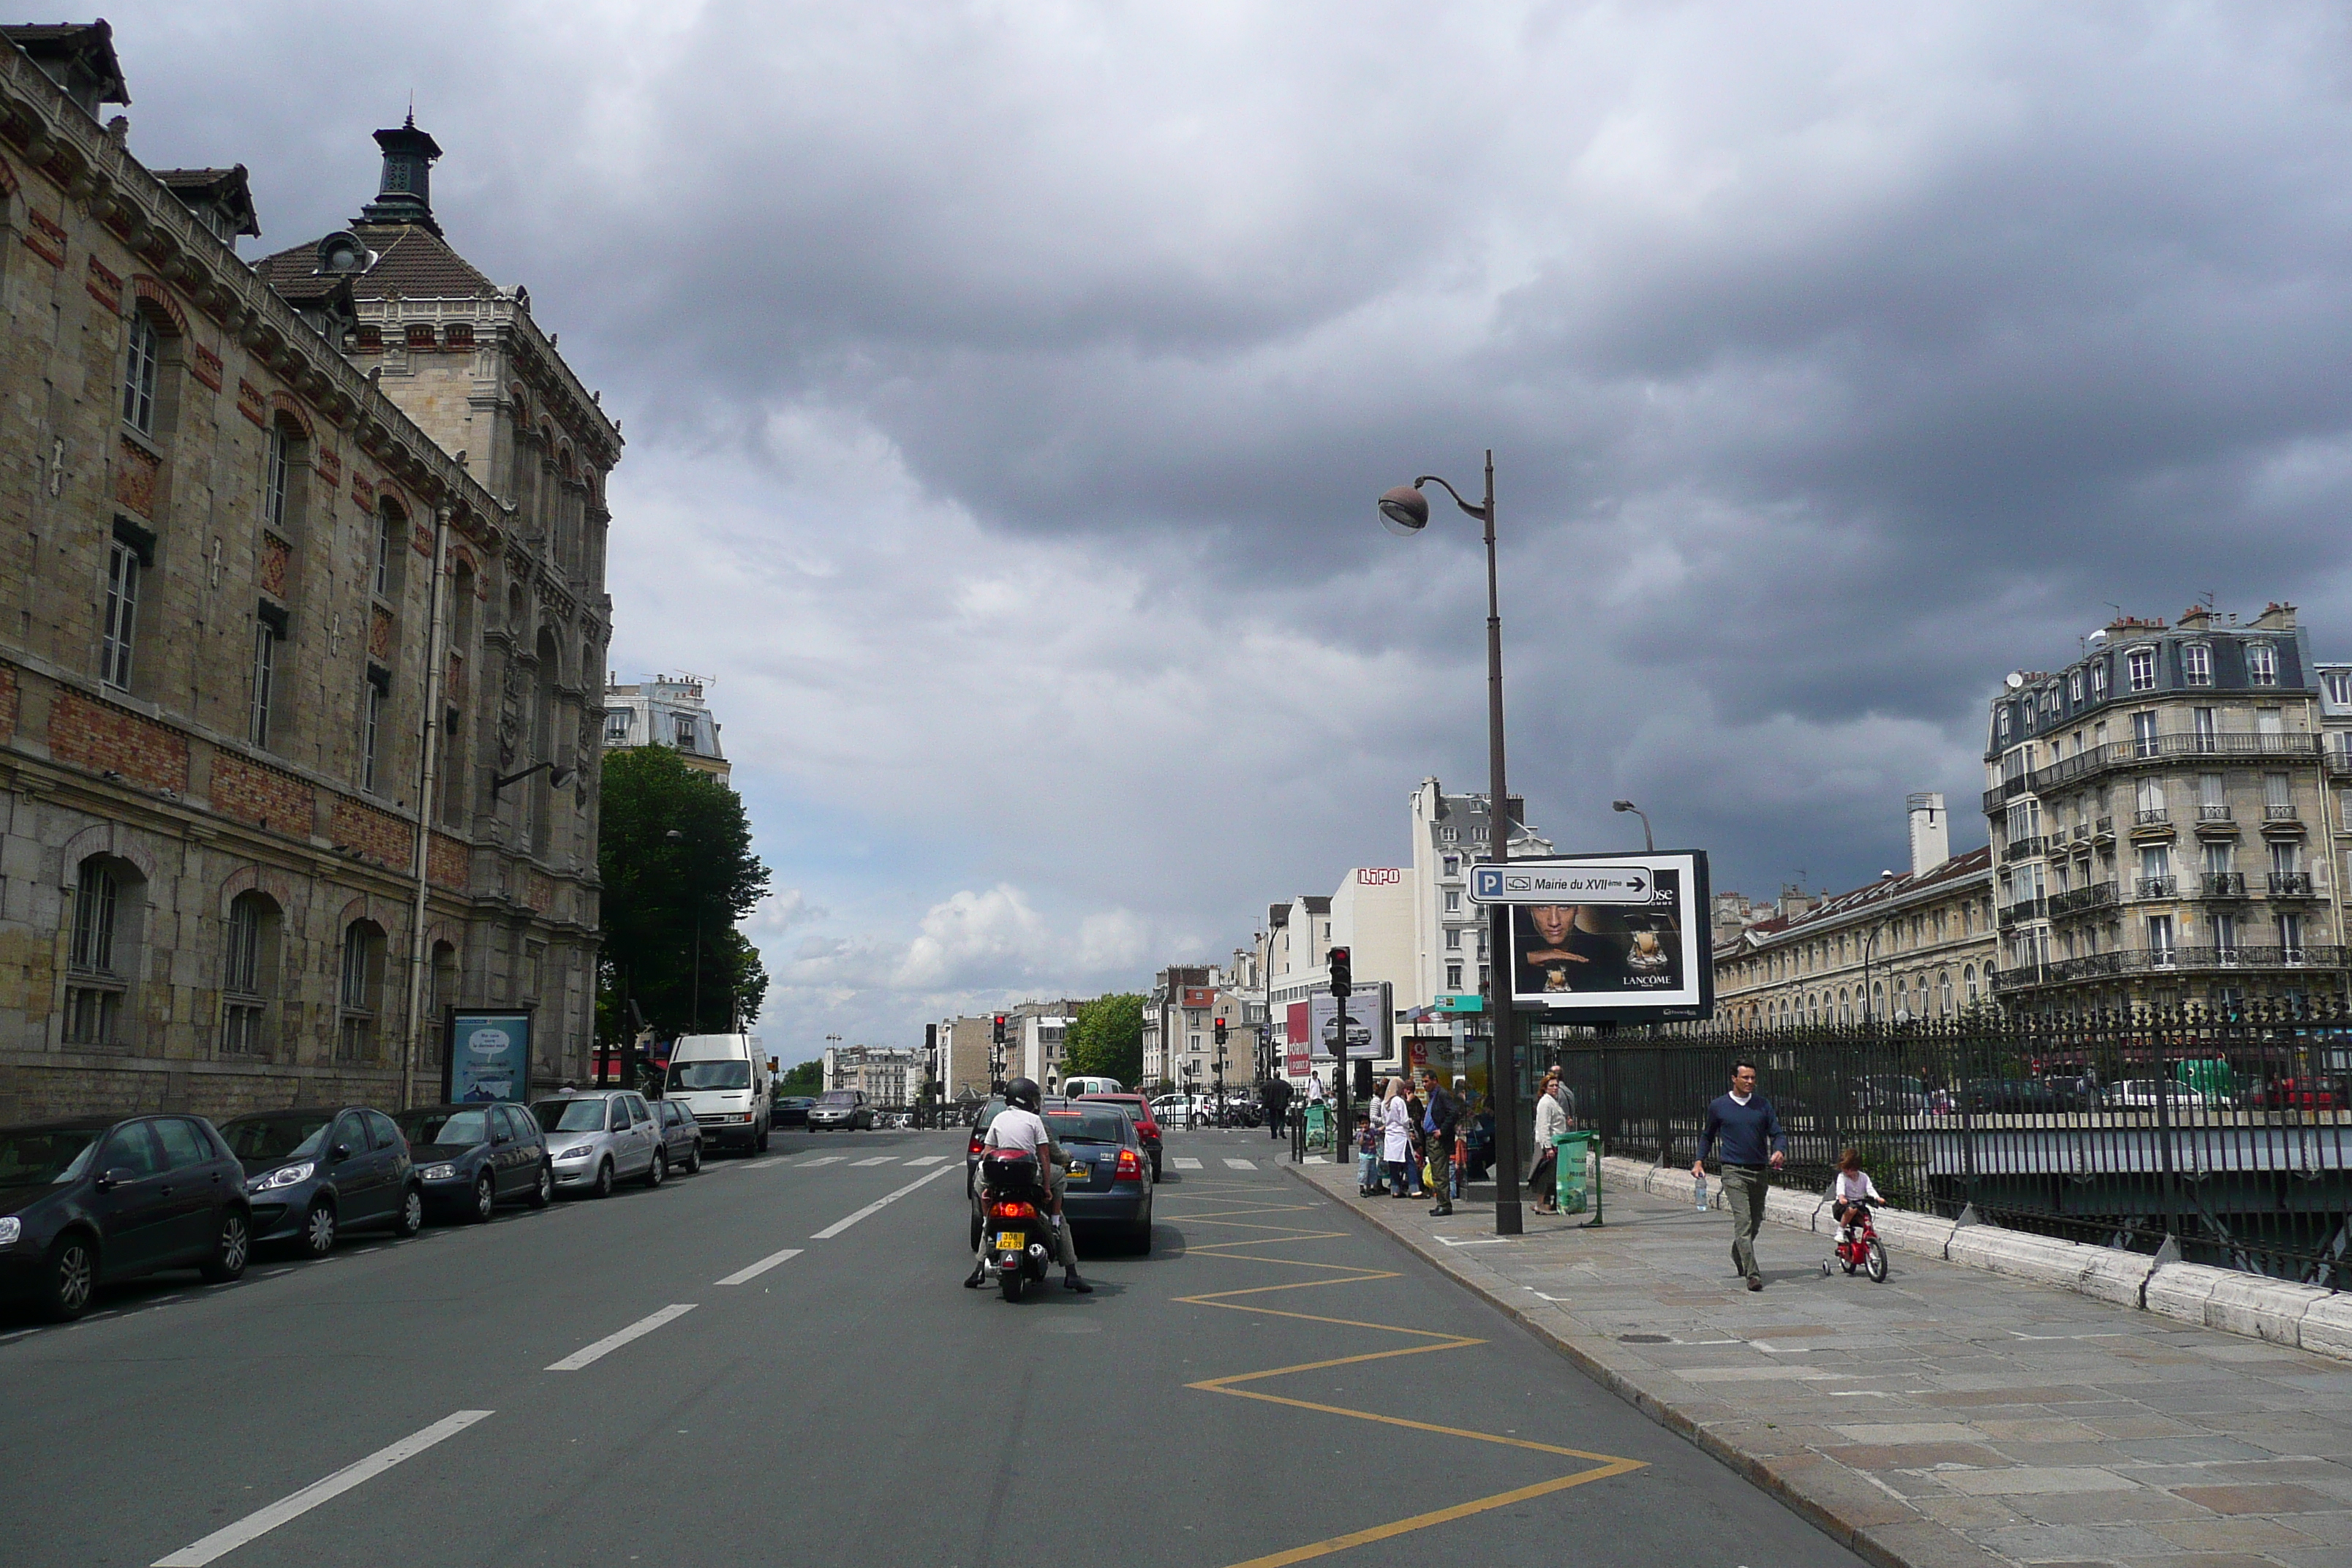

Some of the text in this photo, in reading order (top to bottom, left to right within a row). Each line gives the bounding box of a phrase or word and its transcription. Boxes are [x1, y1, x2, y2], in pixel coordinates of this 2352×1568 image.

[1484, 875, 1497, 892] P
[1534, 878, 1567, 890] Mairie
[1573, 878, 1583, 890] du
[1623, 974, 1672, 985] LANCÔME
[1289, 1041, 1309, 1056] FORUM
[1003, 1233, 1018, 1241] 308
